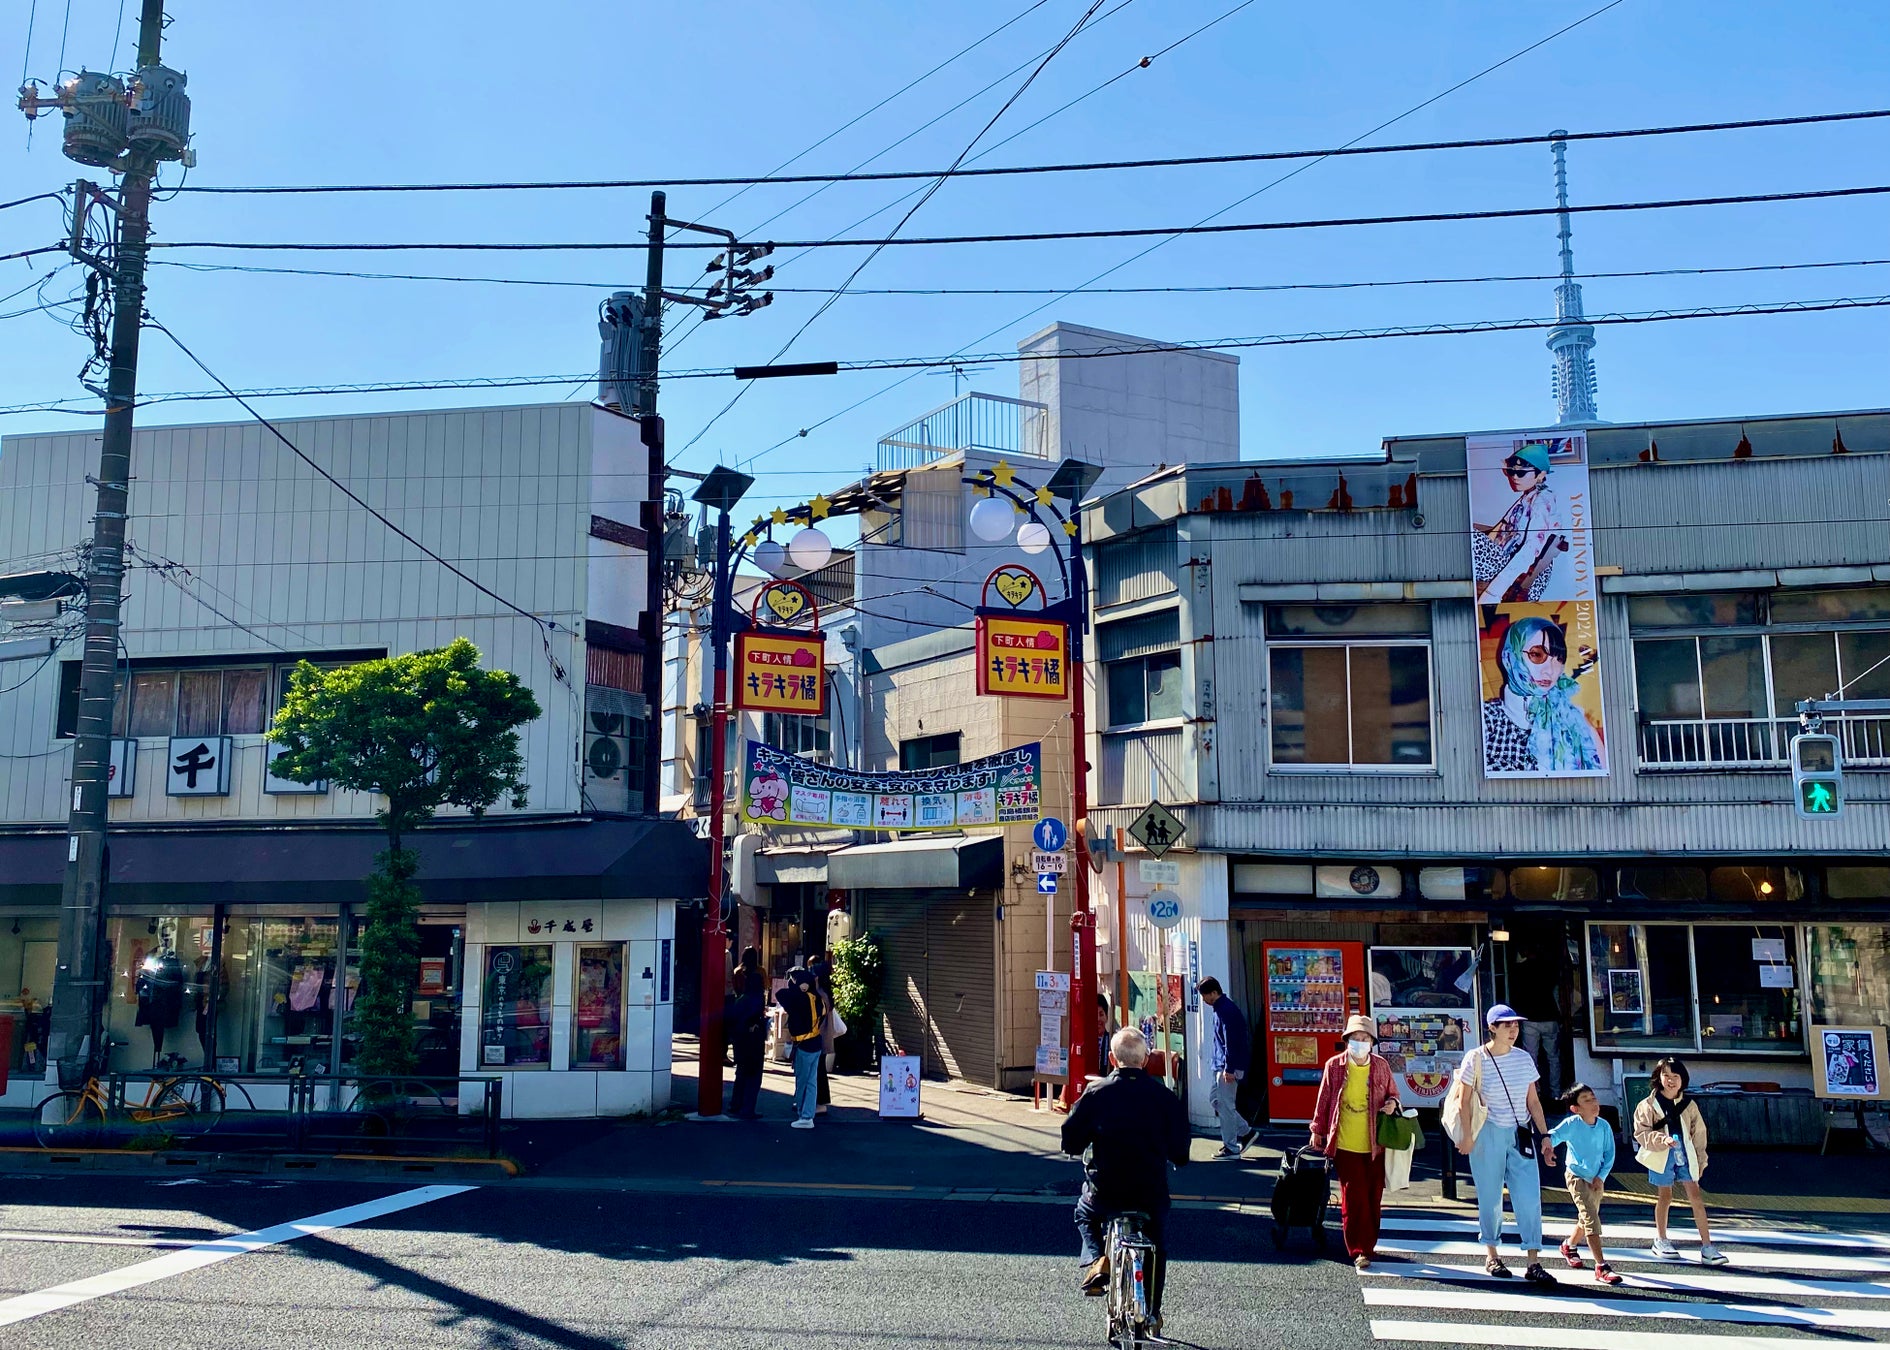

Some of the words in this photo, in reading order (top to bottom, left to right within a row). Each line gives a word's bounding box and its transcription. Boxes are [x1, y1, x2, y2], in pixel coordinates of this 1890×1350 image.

[1570, 493, 1589, 598] YOSHINOYA
[1007, 590, 1023, 600] キラキラ
[1576, 602, 1592, 638] 2024
[994, 635, 1035, 648] 下町人情
[751, 652, 792, 665] 下町人情
[991, 655, 1060, 685] キラキラ橘
[747, 672, 816, 701] キラキラ橘
[172, 742, 216, 789] 千
[880, 796, 909, 806] 離れて
